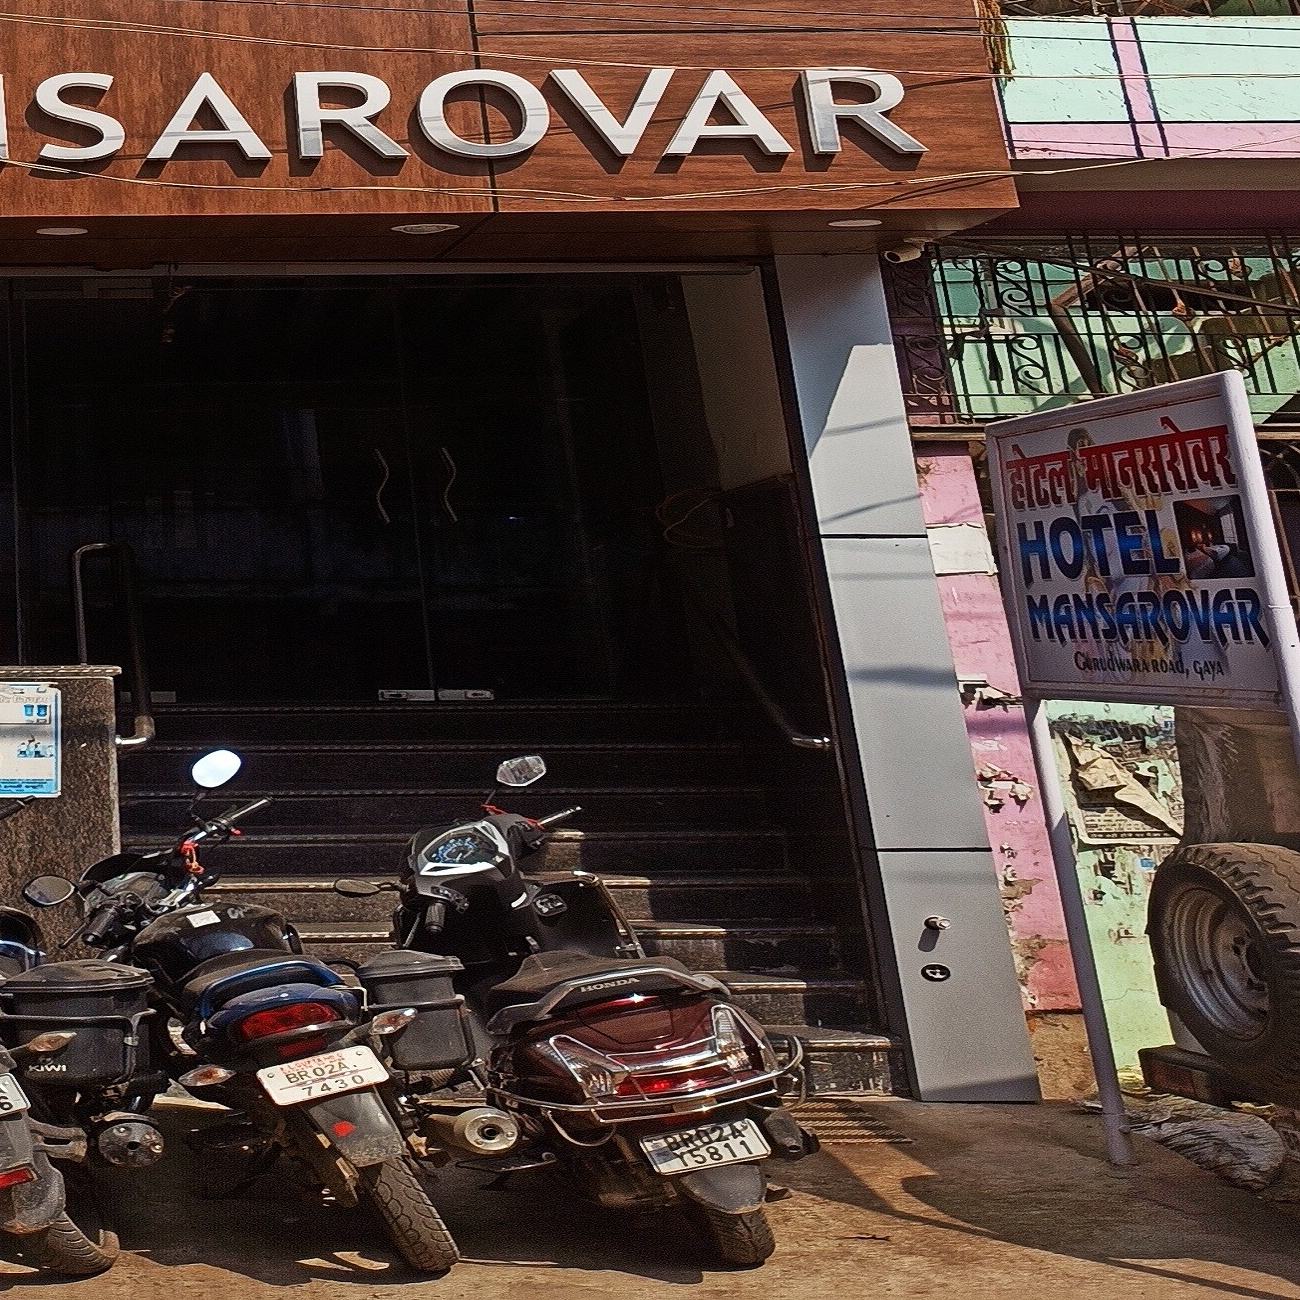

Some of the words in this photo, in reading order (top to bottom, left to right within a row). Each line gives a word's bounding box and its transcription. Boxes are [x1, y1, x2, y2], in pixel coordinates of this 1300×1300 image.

[1016, 510, 1181, 589] HOTEL
[1026, 587, 1271, 650] MANSAROVAR
[580, 977, 640, 993] HONDA
[28, 1064, 67, 1072] KIWI
